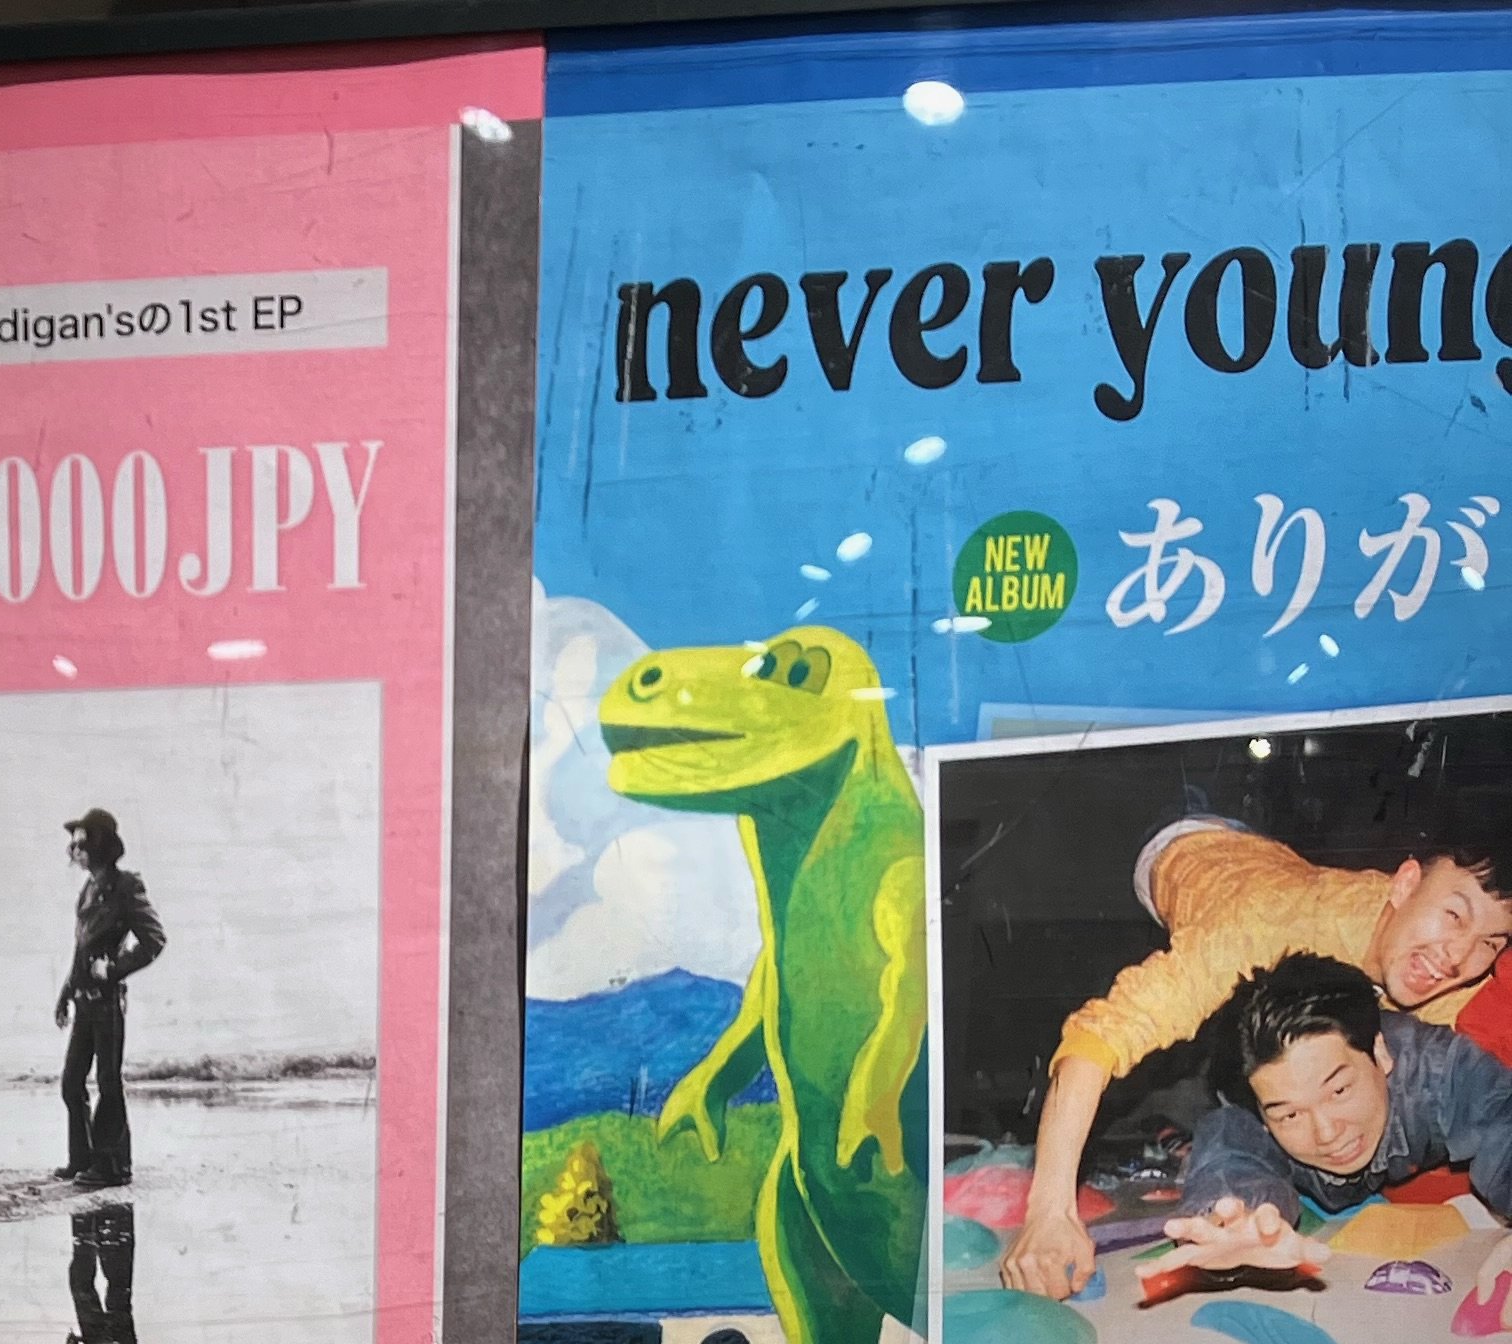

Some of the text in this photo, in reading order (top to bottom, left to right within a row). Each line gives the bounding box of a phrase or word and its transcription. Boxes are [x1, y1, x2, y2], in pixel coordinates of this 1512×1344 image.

[252, 295, 304, 332] EP
[616, 240, 1512, 421] never youn
[986, 533, 1050, 573] NEW
[965, 571, 1066, 613] ALBUM
